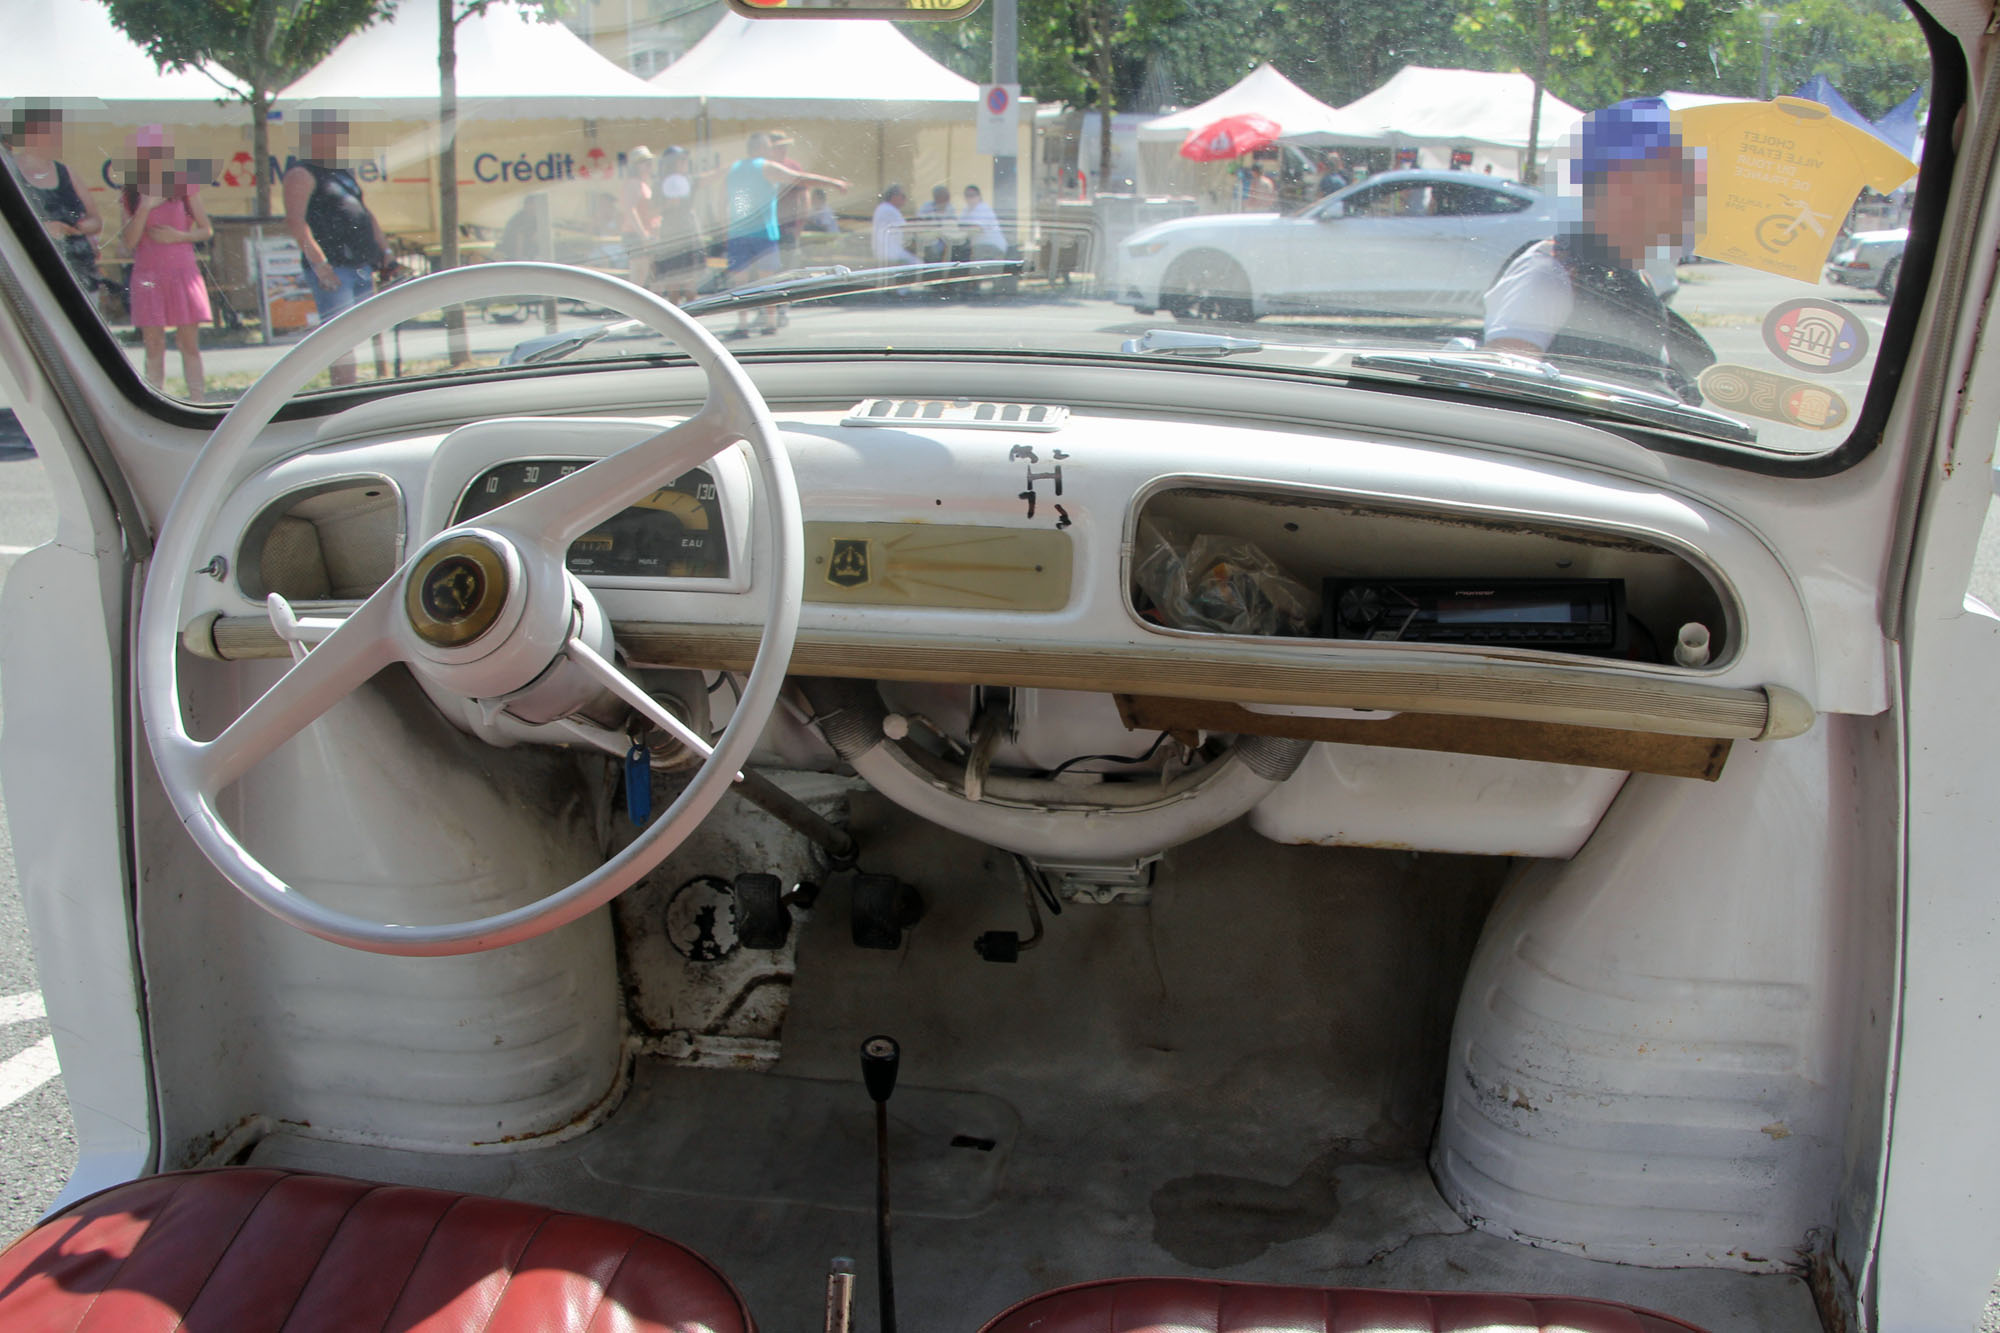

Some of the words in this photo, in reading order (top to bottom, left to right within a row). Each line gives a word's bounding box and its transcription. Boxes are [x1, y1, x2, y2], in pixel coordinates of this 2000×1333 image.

[473, 152, 575, 183] Crédit
[523, 466, 540, 483] 30
[486, 476, 499, 494] 10
[696, 483, 716, 500] 130
[681, 539, 704, 548] EAU
